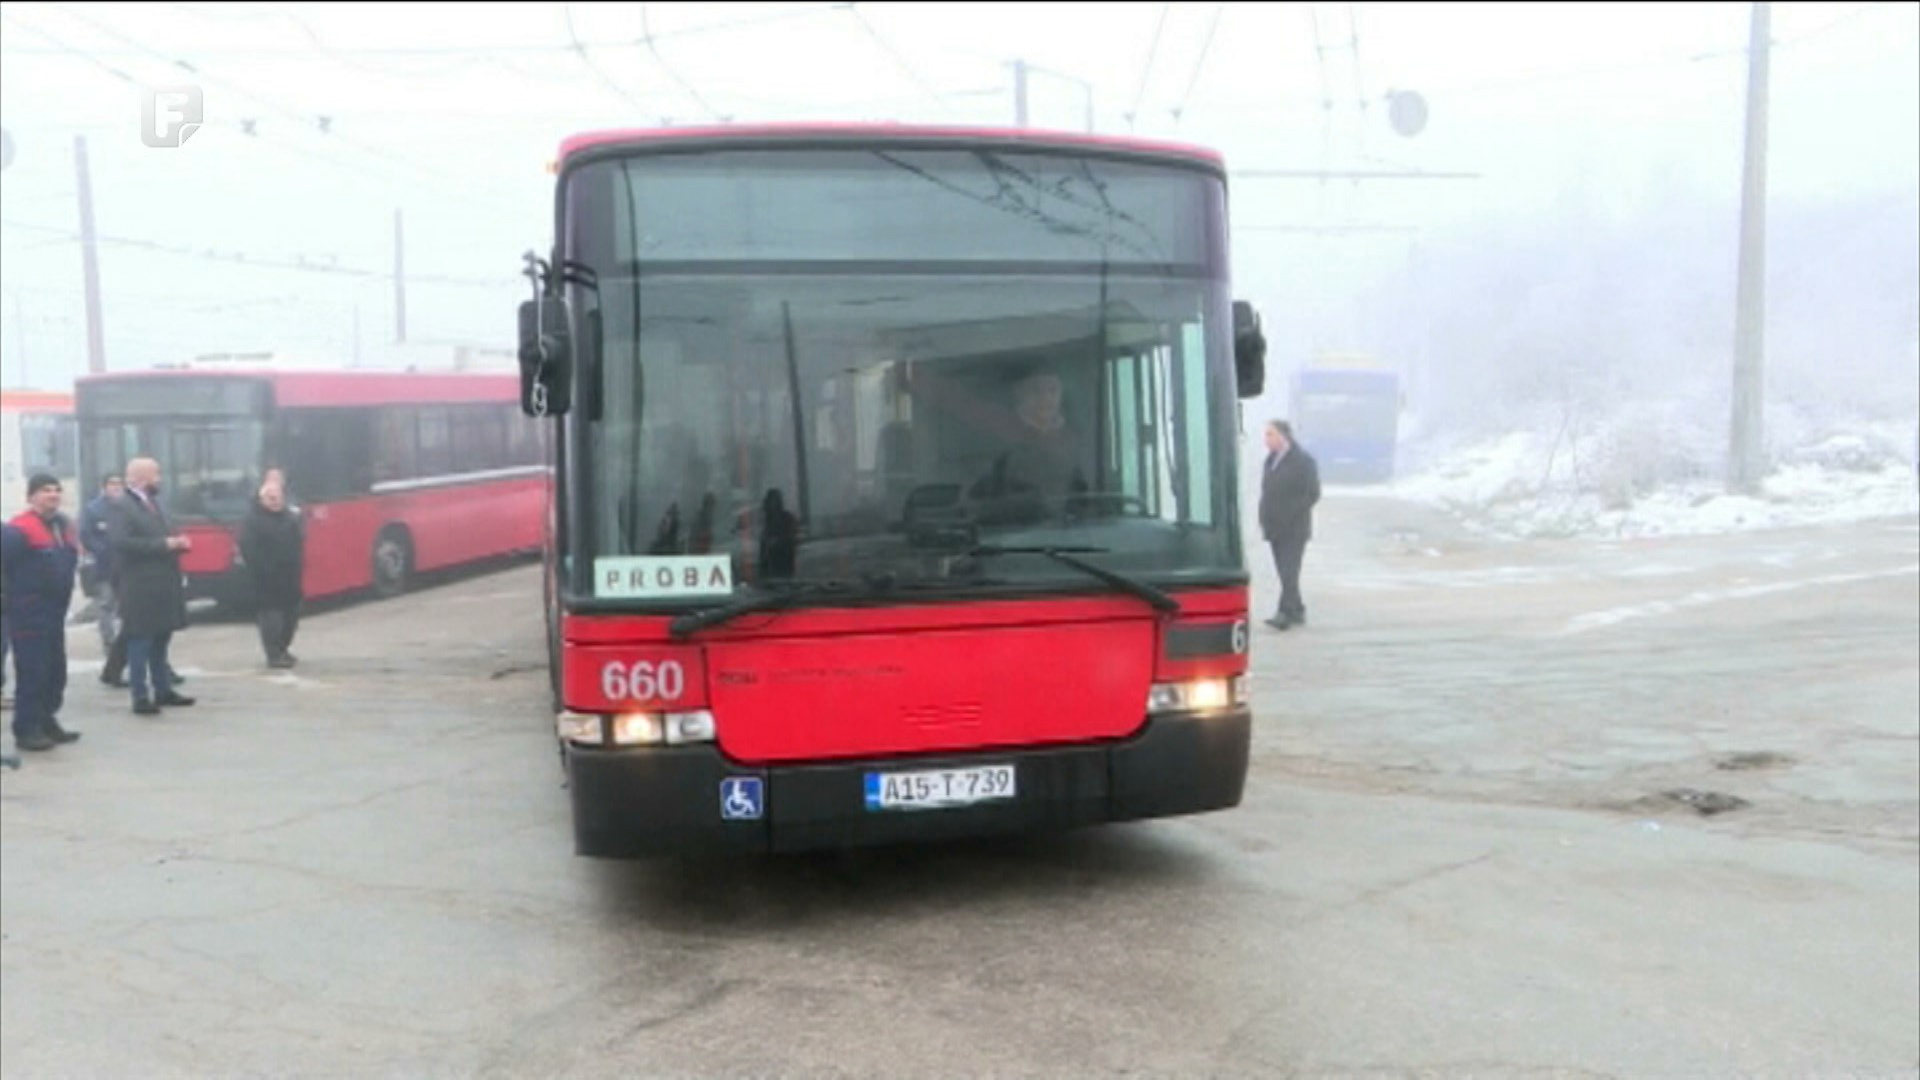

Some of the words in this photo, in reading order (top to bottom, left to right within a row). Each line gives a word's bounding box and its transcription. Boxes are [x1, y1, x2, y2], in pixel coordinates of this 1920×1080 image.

[606, 564, 727, 589] PROBA
[602, 660, 684, 701] 660
[885, 768, 1010, 801] A15-T-739
